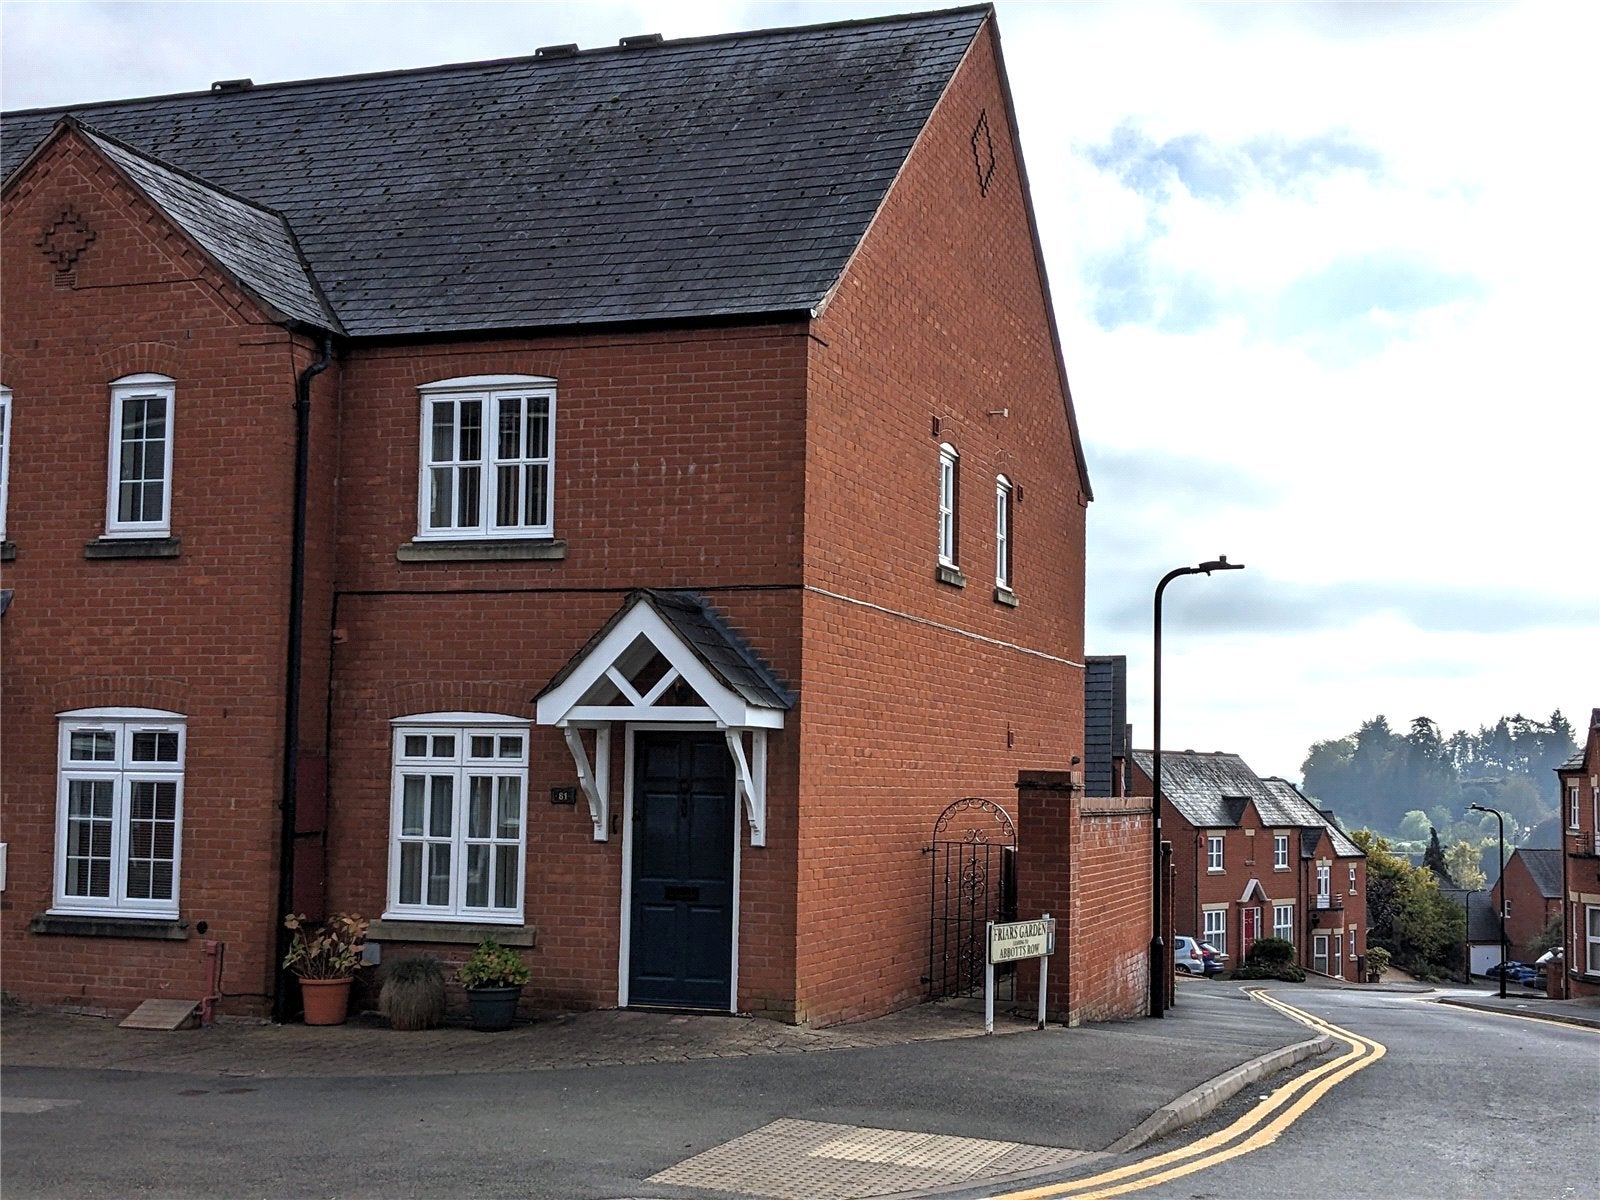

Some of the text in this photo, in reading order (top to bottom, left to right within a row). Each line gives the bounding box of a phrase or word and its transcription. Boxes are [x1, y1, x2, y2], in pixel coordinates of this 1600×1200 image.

[993, 922, 1046, 941] FRIARS GARDEN
[1000, 943, 1040, 958] ABBOTTS ROW
